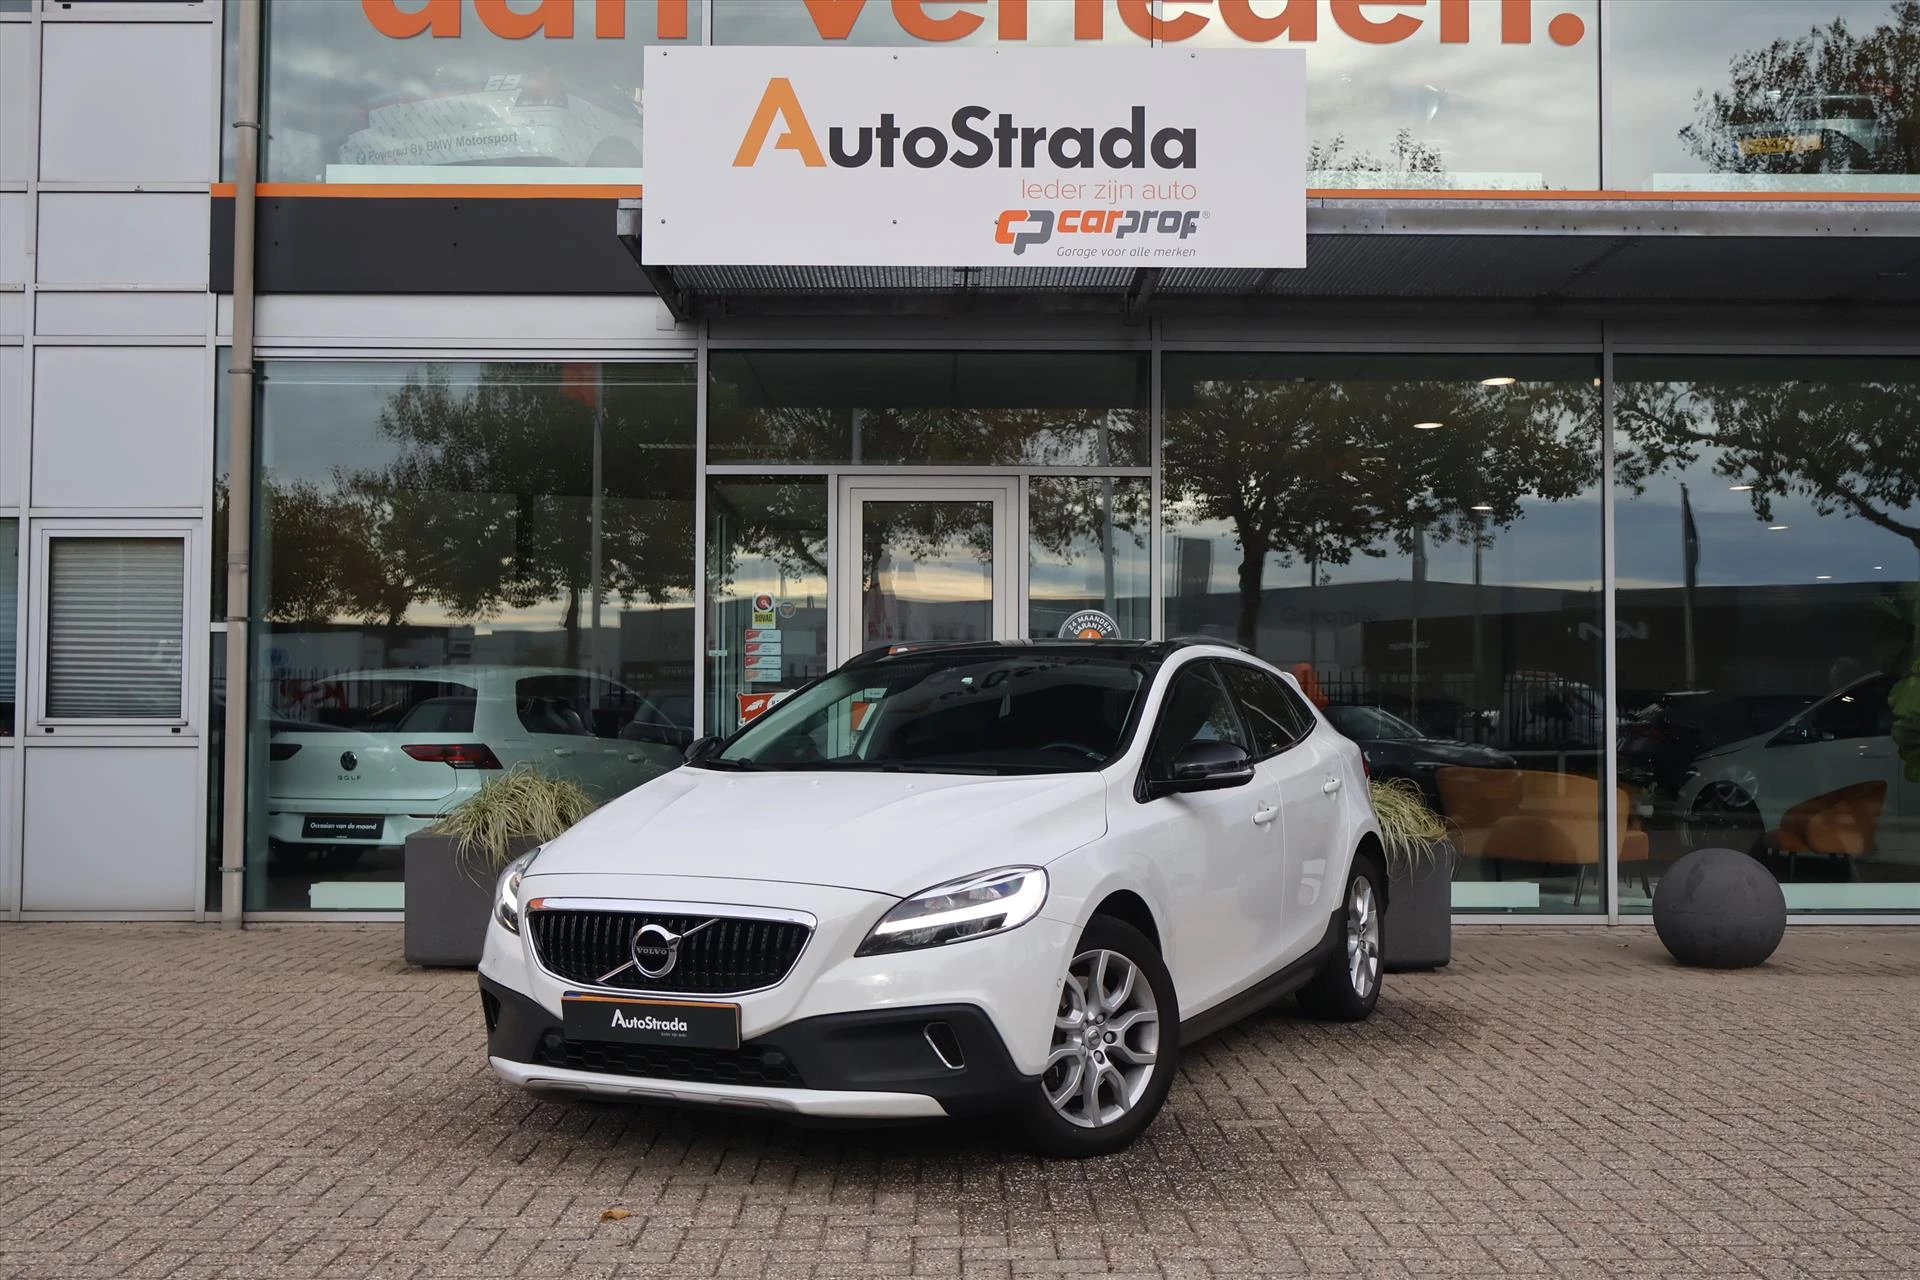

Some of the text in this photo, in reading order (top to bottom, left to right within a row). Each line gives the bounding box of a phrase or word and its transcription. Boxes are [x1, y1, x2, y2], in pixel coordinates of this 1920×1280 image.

[732, 77, 1197, 168] AutoStrada
[410, 143, 424, 156] By
[427, 140, 452, 152] BMW
[455, 131, 518, 149] Motorsport
[1021, 178, 1197, 205] Ieder zijn auto
[1057, 210, 1201, 240] carprof
[1056, 246, 1196, 259] Garage voor alle merken
[1068, 615, 1113, 632] 24 MAANDEN
[1073, 622, 1107, 636] GARANTIE
[637, 947, 667, 955] VOLVO
[611, 1008, 688, 1032] AutoStrada
